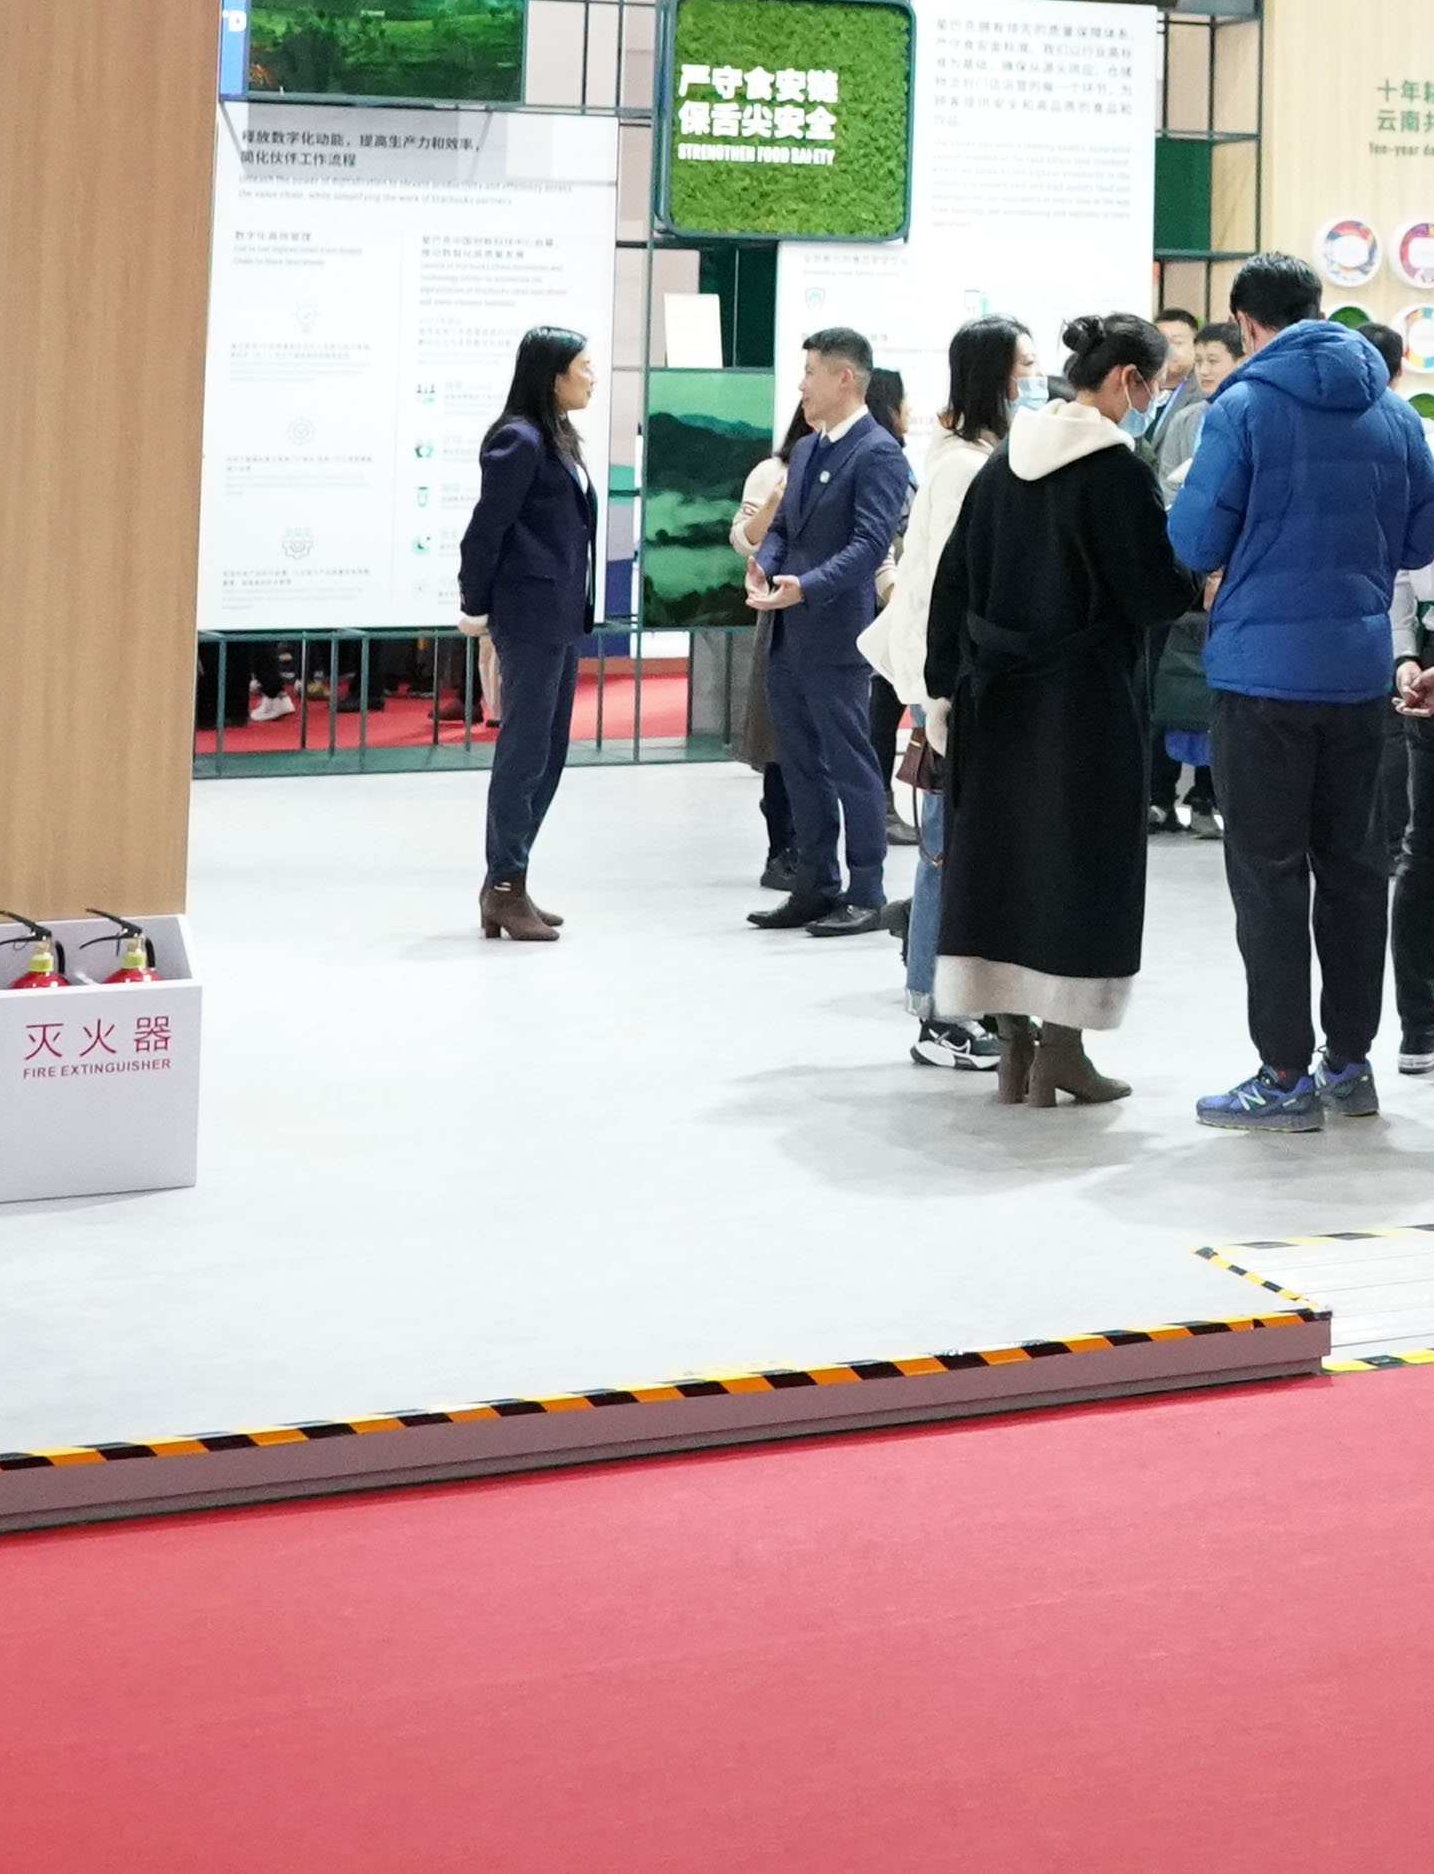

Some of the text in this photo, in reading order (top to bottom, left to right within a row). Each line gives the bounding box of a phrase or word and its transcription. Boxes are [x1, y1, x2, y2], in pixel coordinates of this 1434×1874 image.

[678, 100, 838, 140] 保舌尖安全
[678, 142, 756, 163] STRENGTHEN
[757, 145, 790, 163] FOOD
[24, 1015, 172, 1061] 灭火器
[23, 1058, 171, 1079] FIRE EXTINGUISHER
